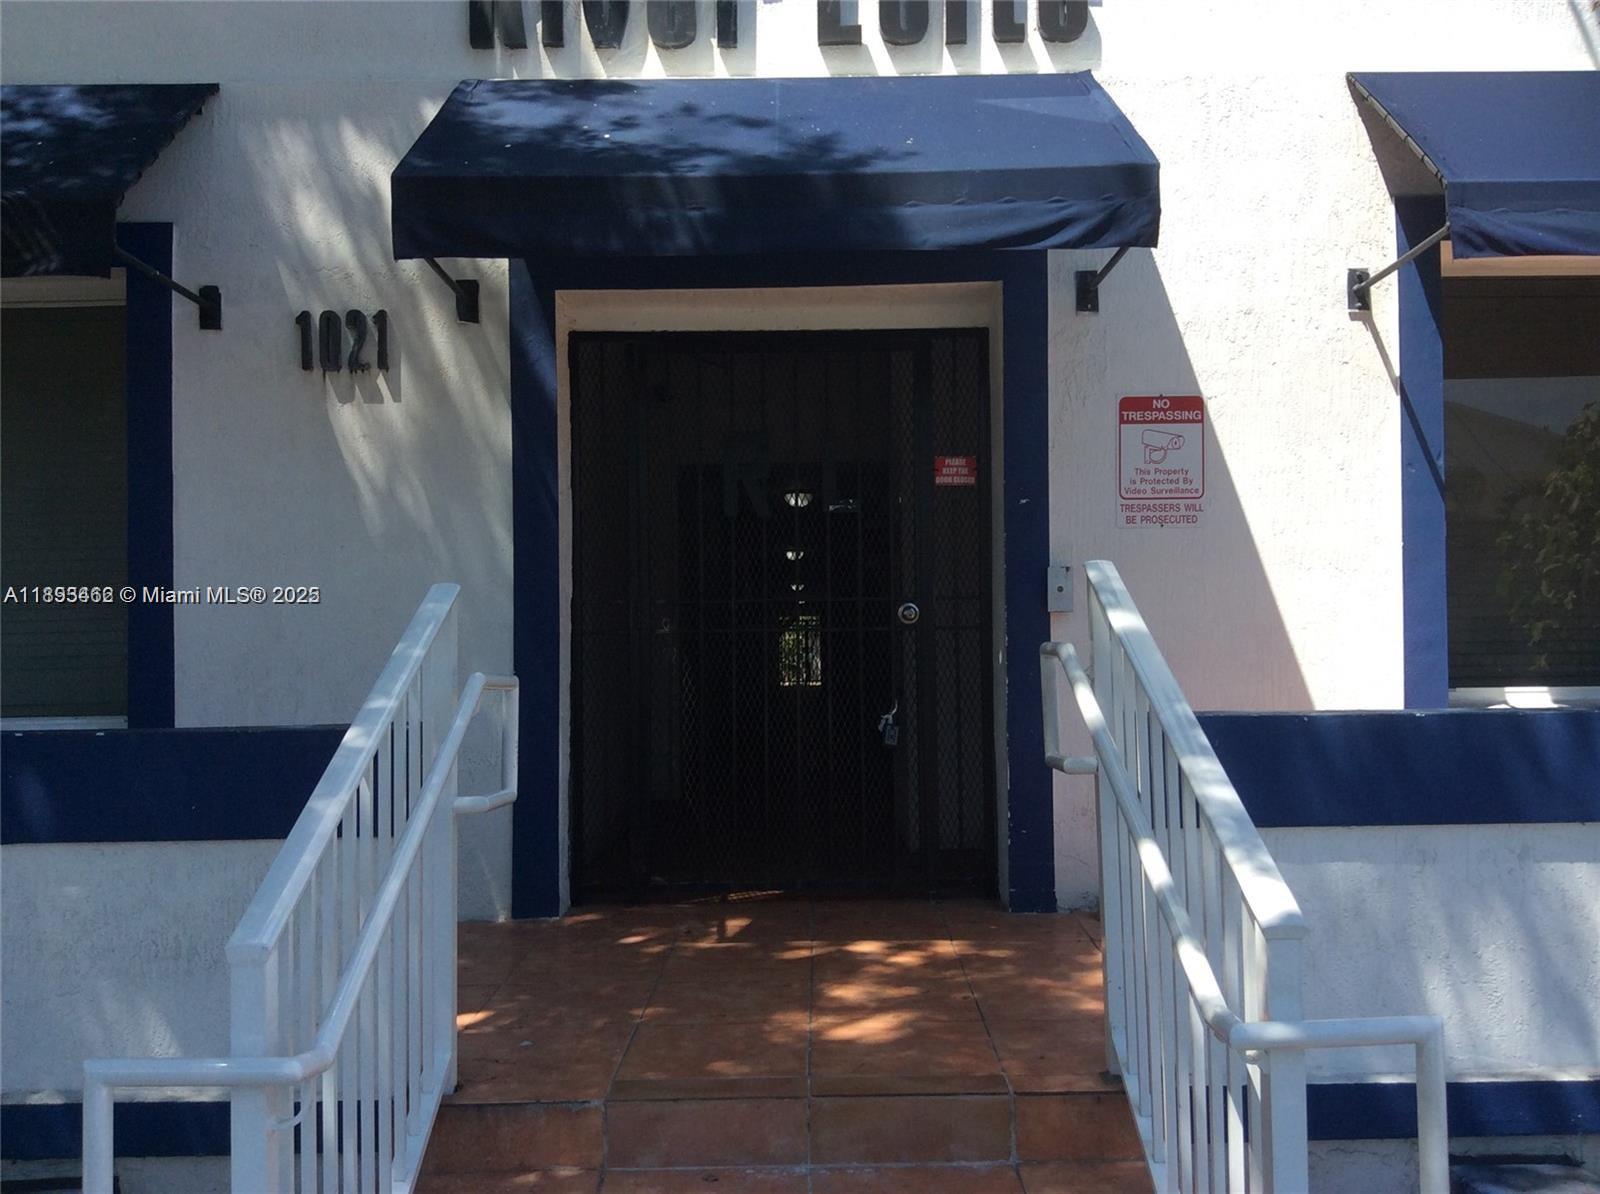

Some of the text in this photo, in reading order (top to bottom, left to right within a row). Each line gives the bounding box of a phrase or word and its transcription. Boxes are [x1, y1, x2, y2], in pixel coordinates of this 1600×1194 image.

[295, 309, 389, 373] 1021
[1152, 399, 1170, 409] NO
[1121, 411, 1202, 421] TRESPASSING
[1154, 467, 1189, 476] Property
[1183, 478, 1194, 486] By
[1124, 487, 1200, 495] Video Surveillance
[1120, 503, 1204, 513] TRESPASSERS WILL
[1126, 515, 1198, 524] BE PROSECUTED
